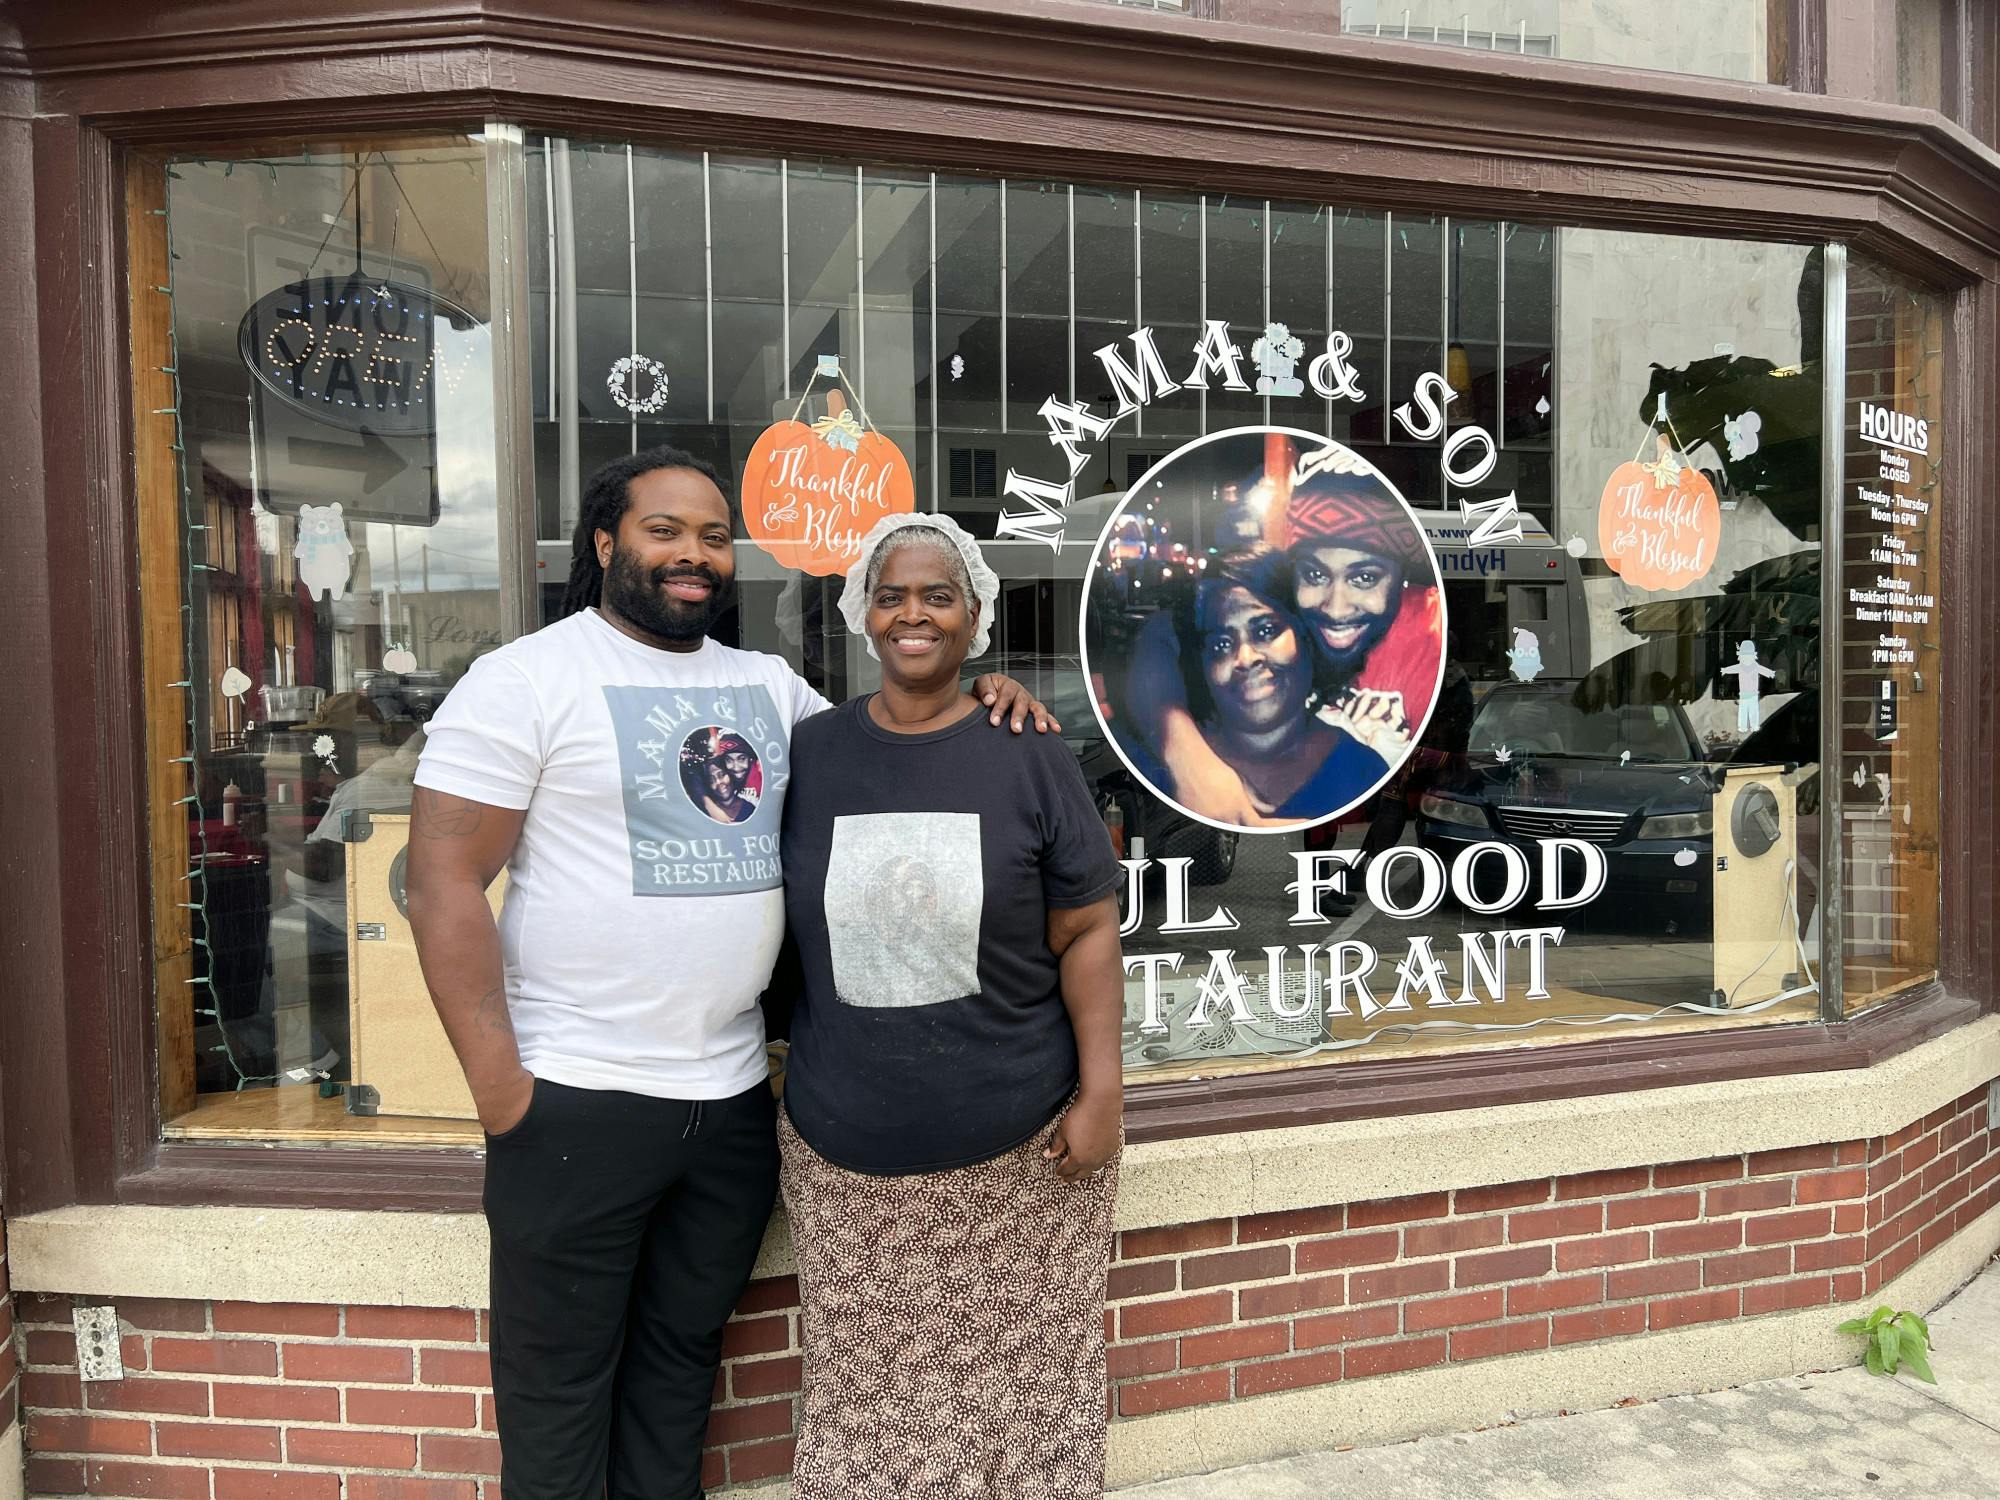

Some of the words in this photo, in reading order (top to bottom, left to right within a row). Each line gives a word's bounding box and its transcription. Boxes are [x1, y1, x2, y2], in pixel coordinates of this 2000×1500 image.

[267, 318, 475, 395] OPEN
[995, 319, 1252, 557] MAMA
[1308, 330, 1366, 402] &
[1392, 371, 1524, 549] SON
[1860, 401, 1928, 450] HOURS
[1880, 449, 1909, 470] Monday
[1880, 465, 1910, 483] CLOSED
[769, 445, 894, 516] Thankful
[1616, 481, 1704, 539] Thankful
[1858, 486, 1890, 507] Tuesday
[1896, 494, 1928, 514] Thursday
[762, 493, 800, 531] &
[803, 502, 862, 558] Bless
[1871, 506, 1891, 522] Noon
[1892, 511, 1901, 524] to
[1901, 512, 1917, 526] 6PM
[1613, 521, 1638, 555] &
[1639, 528, 1704, 575] Blessed
[1870, 548, 1892, 563] 11AM
[1892, 552, 1901, 565] to
[1902, 553, 1917, 566] 7PM
[1882, 534, 1905, 552] Friday
[1849, 588, 1888, 604] Breakfast
[1889, 592, 1905, 606] 8AM
[1906, 594, 1913, 606] to
[1914, 594, 1934, 607] 11AM
[1877, 575, 1910, 593] Saturday
[1856, 607, 1882, 621] Dinner
[1883, 609, 1904, 622] 11AM
[1904, 610, 1913, 623] to
[1913, 611, 1928, 624] 8PM
[1872, 650, 1888, 662] 1PM
[1889, 650, 1898, 662] to
[1898, 651, 1914, 663] 6PM
[1879, 634, 1907, 650] Sunday
[635, 694, 703, 802] MAMA
[713, 695, 737, 722] &
[748, 716, 790, 793] SON
[635, 838, 735, 861] SOUL
[743, 831, 781, 857] FOO
[1284, 837, 1609, 927] FOOD
[1122, 926, 1567, 1034] TAURANT
